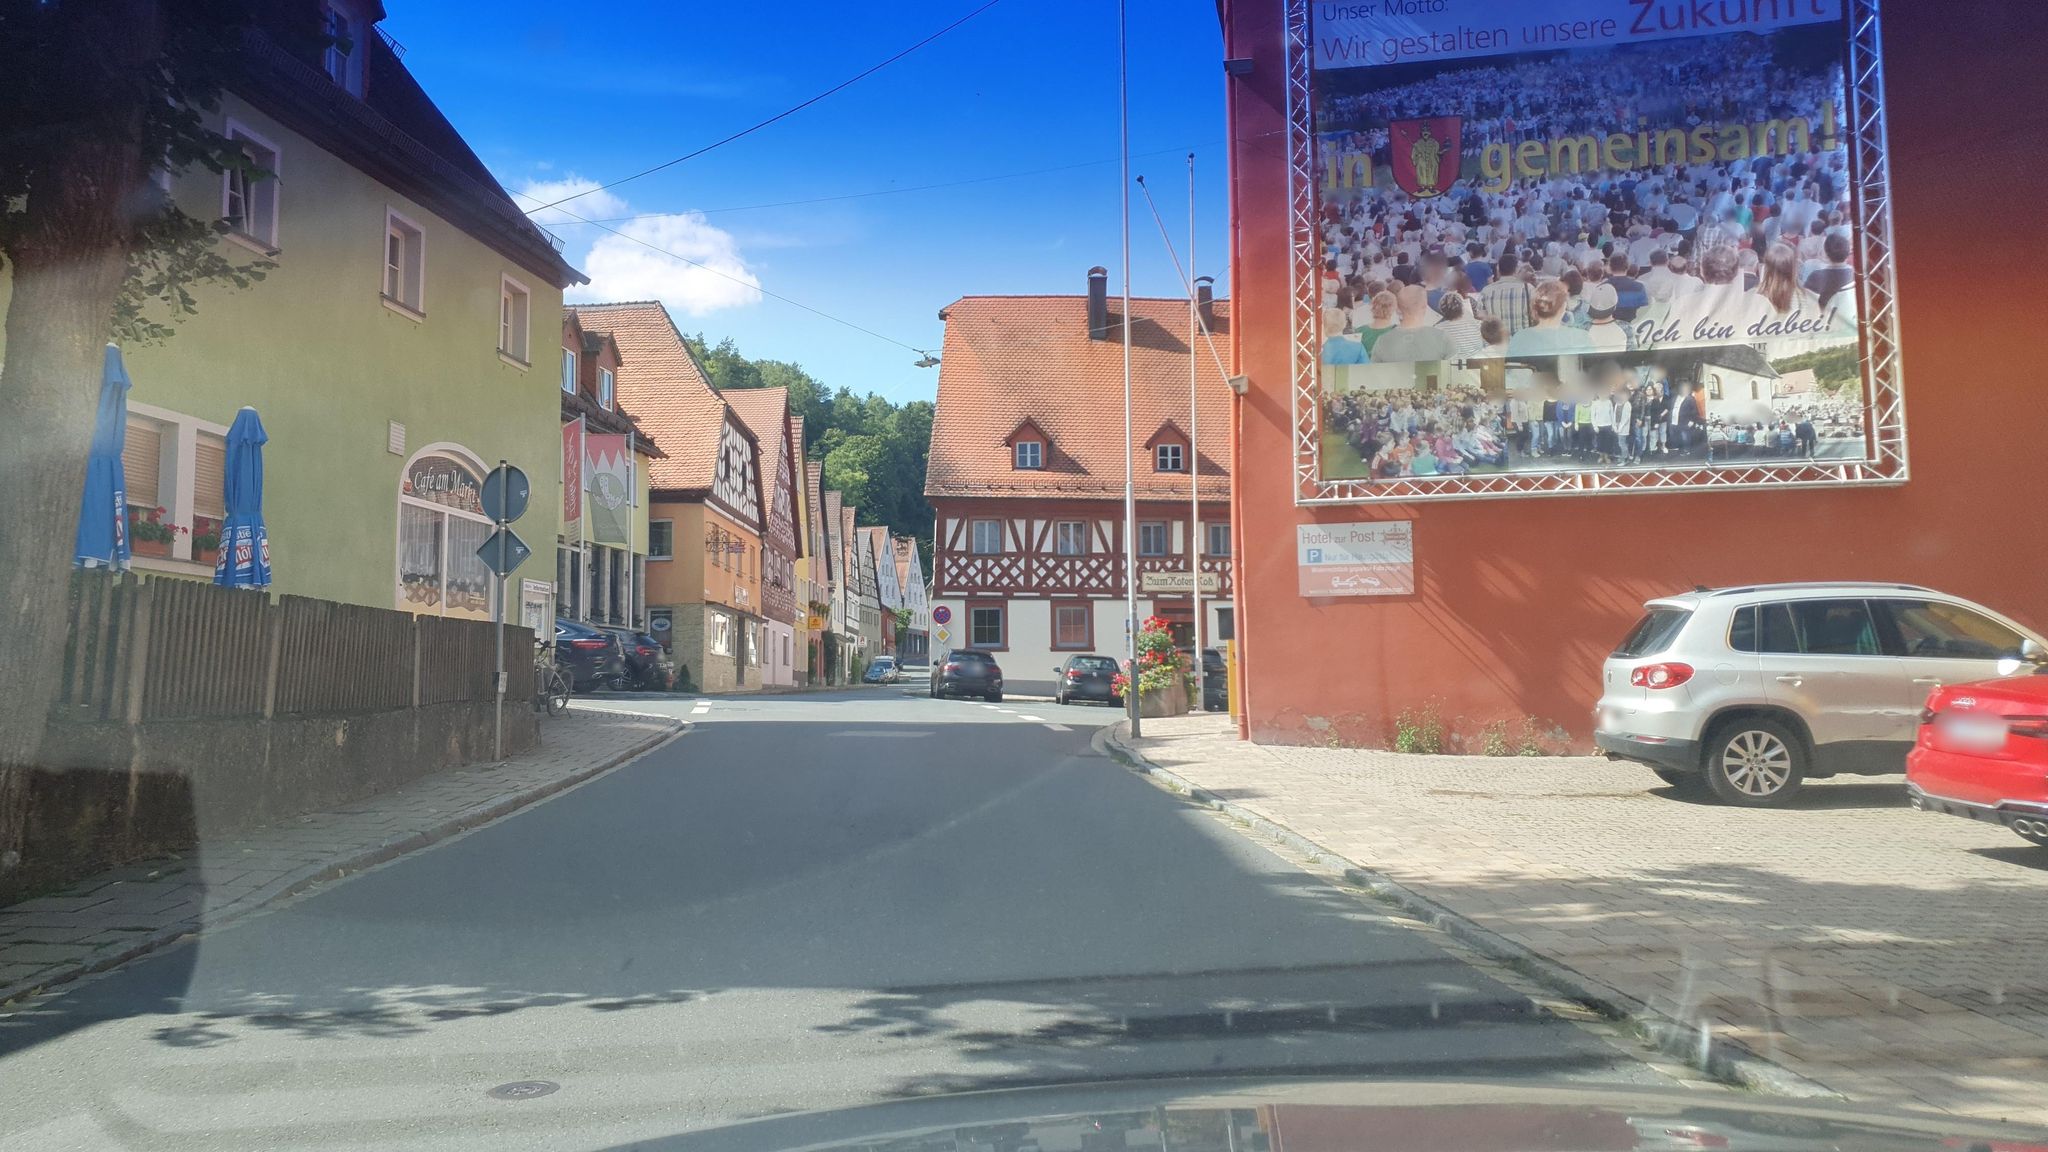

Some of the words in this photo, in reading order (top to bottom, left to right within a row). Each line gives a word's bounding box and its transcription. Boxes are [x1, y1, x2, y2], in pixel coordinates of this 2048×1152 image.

[1322, 3, 1377, 22] Unser
[1384, 0, 1449, 17] Motto:
[1321, 36, 1372, 62] Wir
[1381, 25, 1509, 63] gestalten
[1521, 17, 1617, 44] unsere
[1326, 141, 1373, 190] in
[1480, 100, 1837, 192] gemeinsam!
[1635, 318, 1681, 347] Ich
[1693, 315, 1736, 341] bin
[1746, 306, 1838, 337] dabei!
[414, 466, 435, 496] Cafe
[435, 472, 449, 492] am
[450, 469, 477, 503] Markt
[1302, 532, 1332, 544] Hotel
[1350, 530, 1375, 543] Post
[1310, 551, 1319, 562] P
